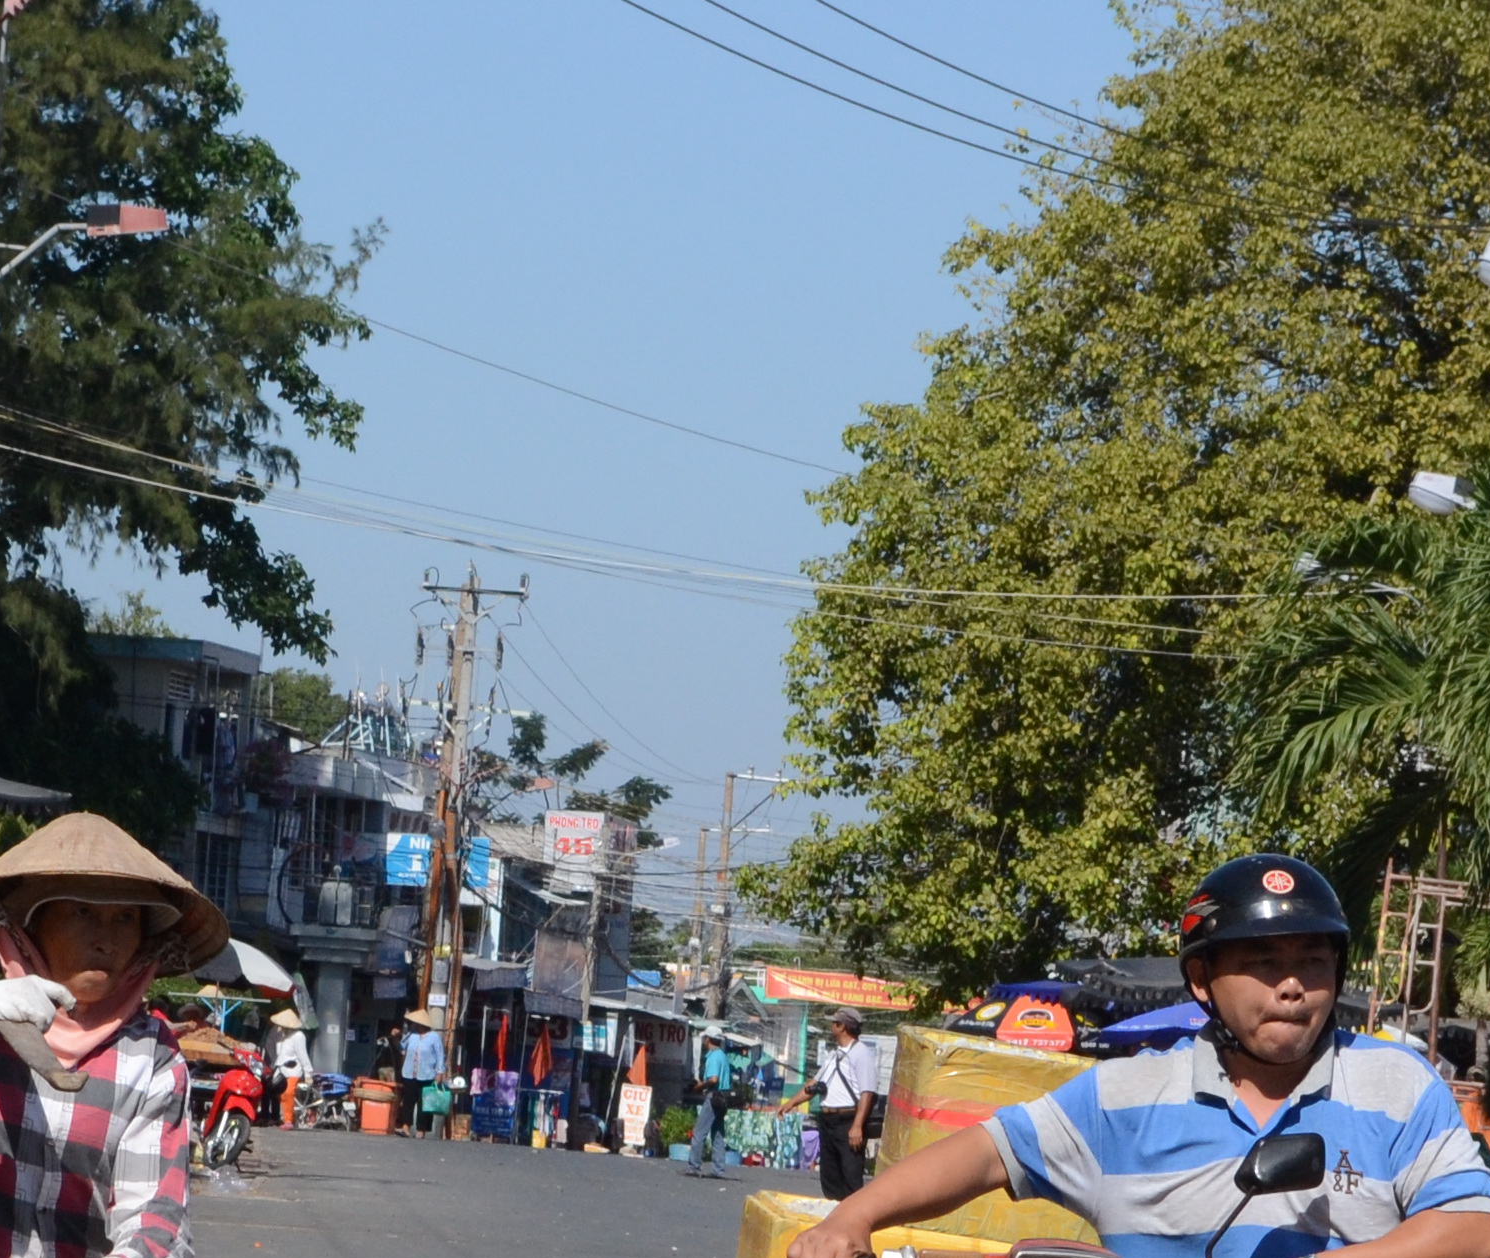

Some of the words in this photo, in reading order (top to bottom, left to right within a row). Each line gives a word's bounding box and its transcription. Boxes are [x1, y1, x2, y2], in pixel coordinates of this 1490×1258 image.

[554, 836, 595, 856] 45
[659, 1022, 687, 1047] TRỌ
[625, 1103, 644, 1116] XE
